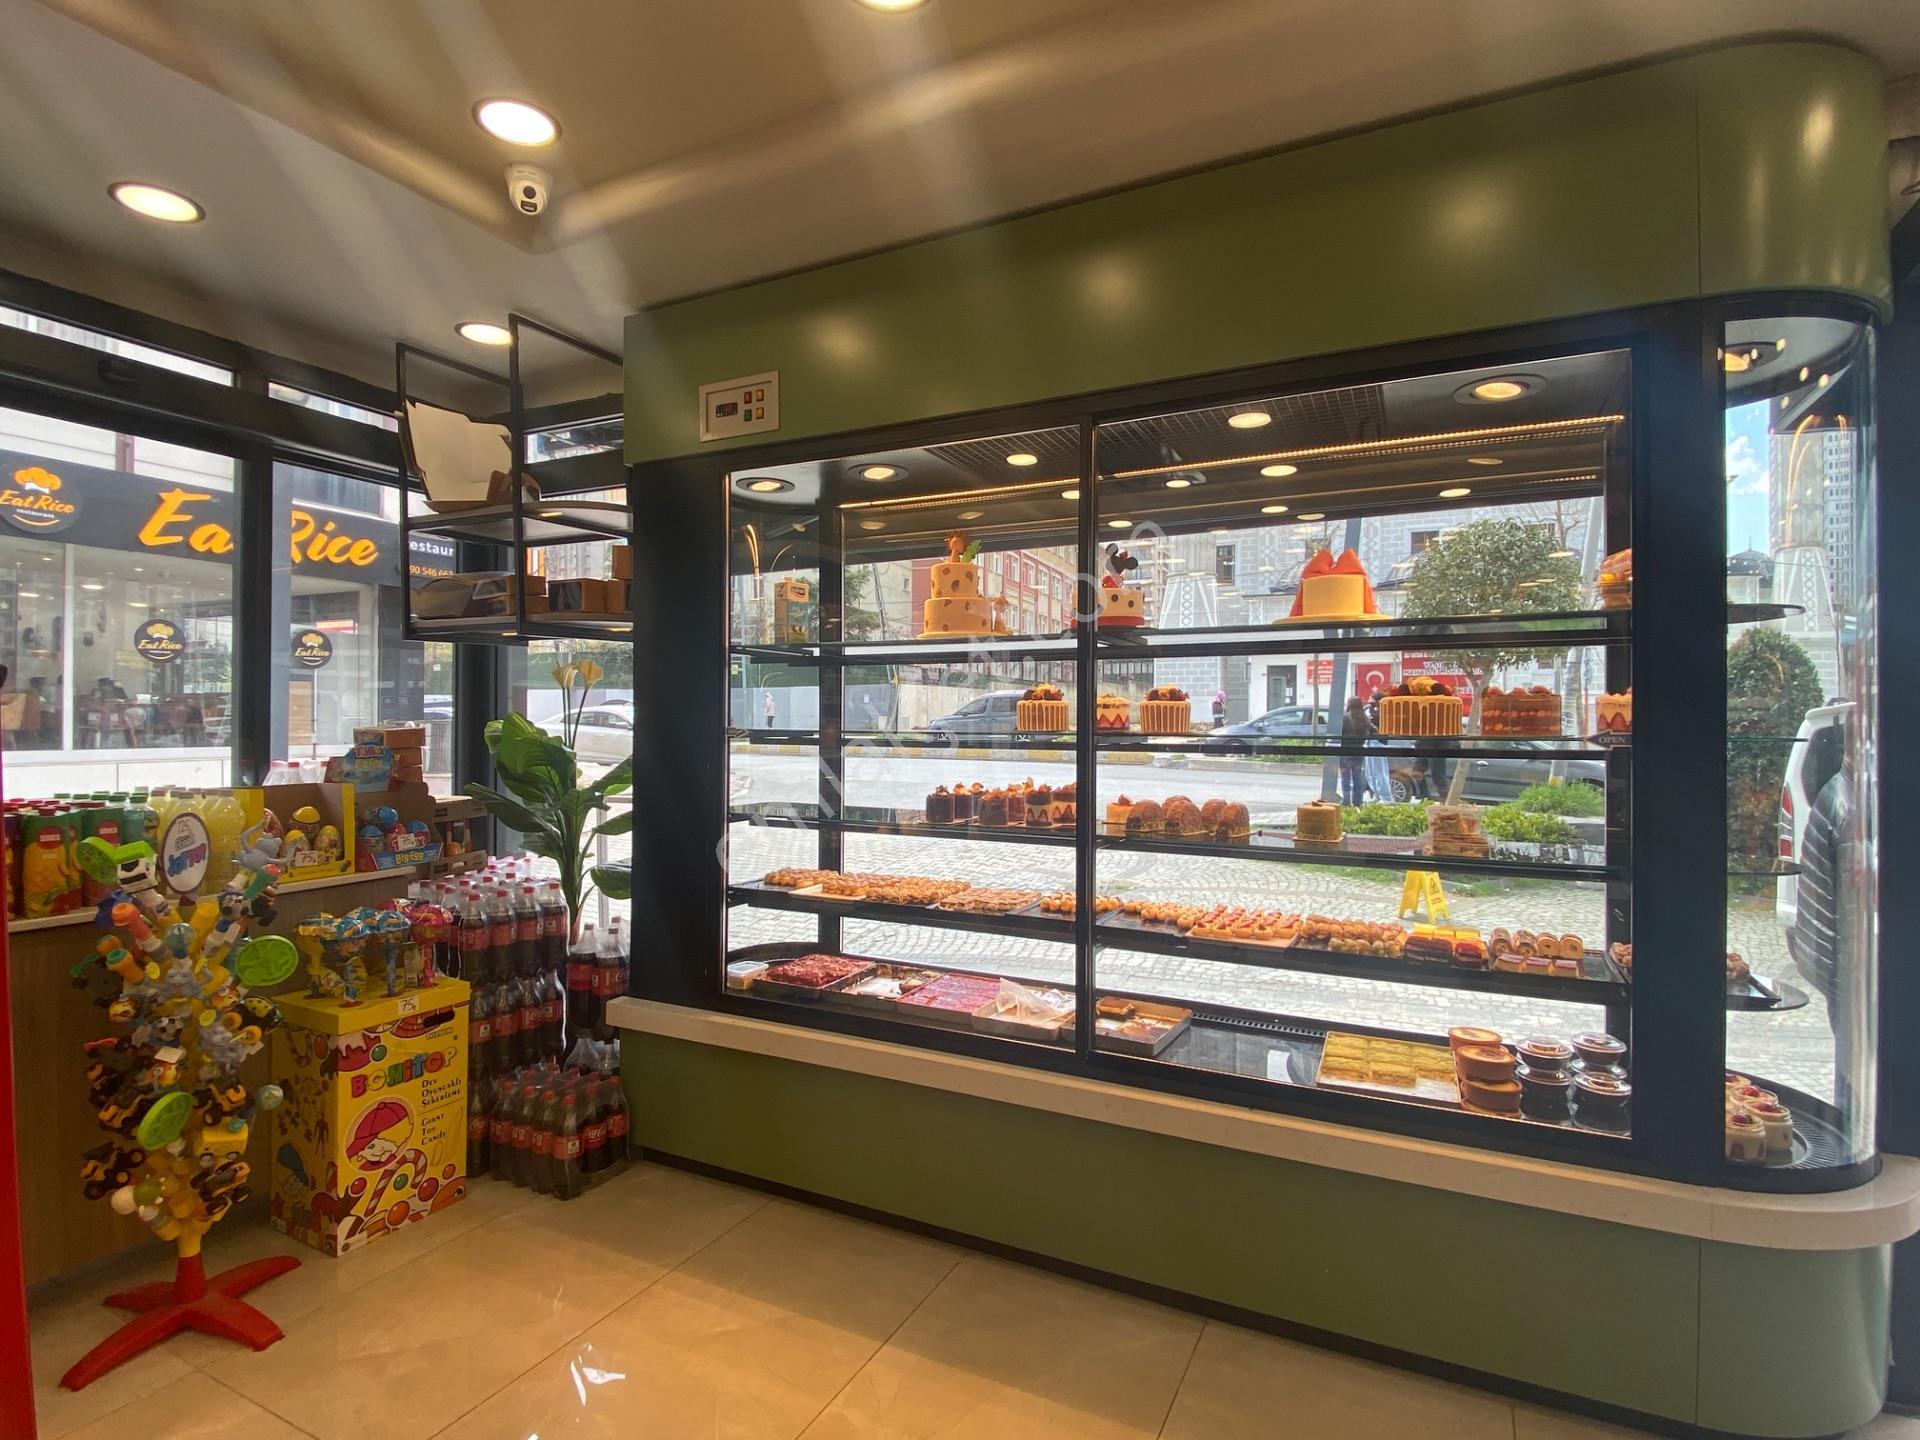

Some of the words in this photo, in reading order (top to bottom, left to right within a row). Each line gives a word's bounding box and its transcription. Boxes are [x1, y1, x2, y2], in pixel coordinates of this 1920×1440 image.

[0, 489, 34, 508] Eat
[34, 495, 75, 513] Rice
[138, 488, 234, 554] Ea
[408, 541, 455, 556] estaur
[409, 565, 420, 575] 90
[1598, 736, 1626, 744] OPEN
